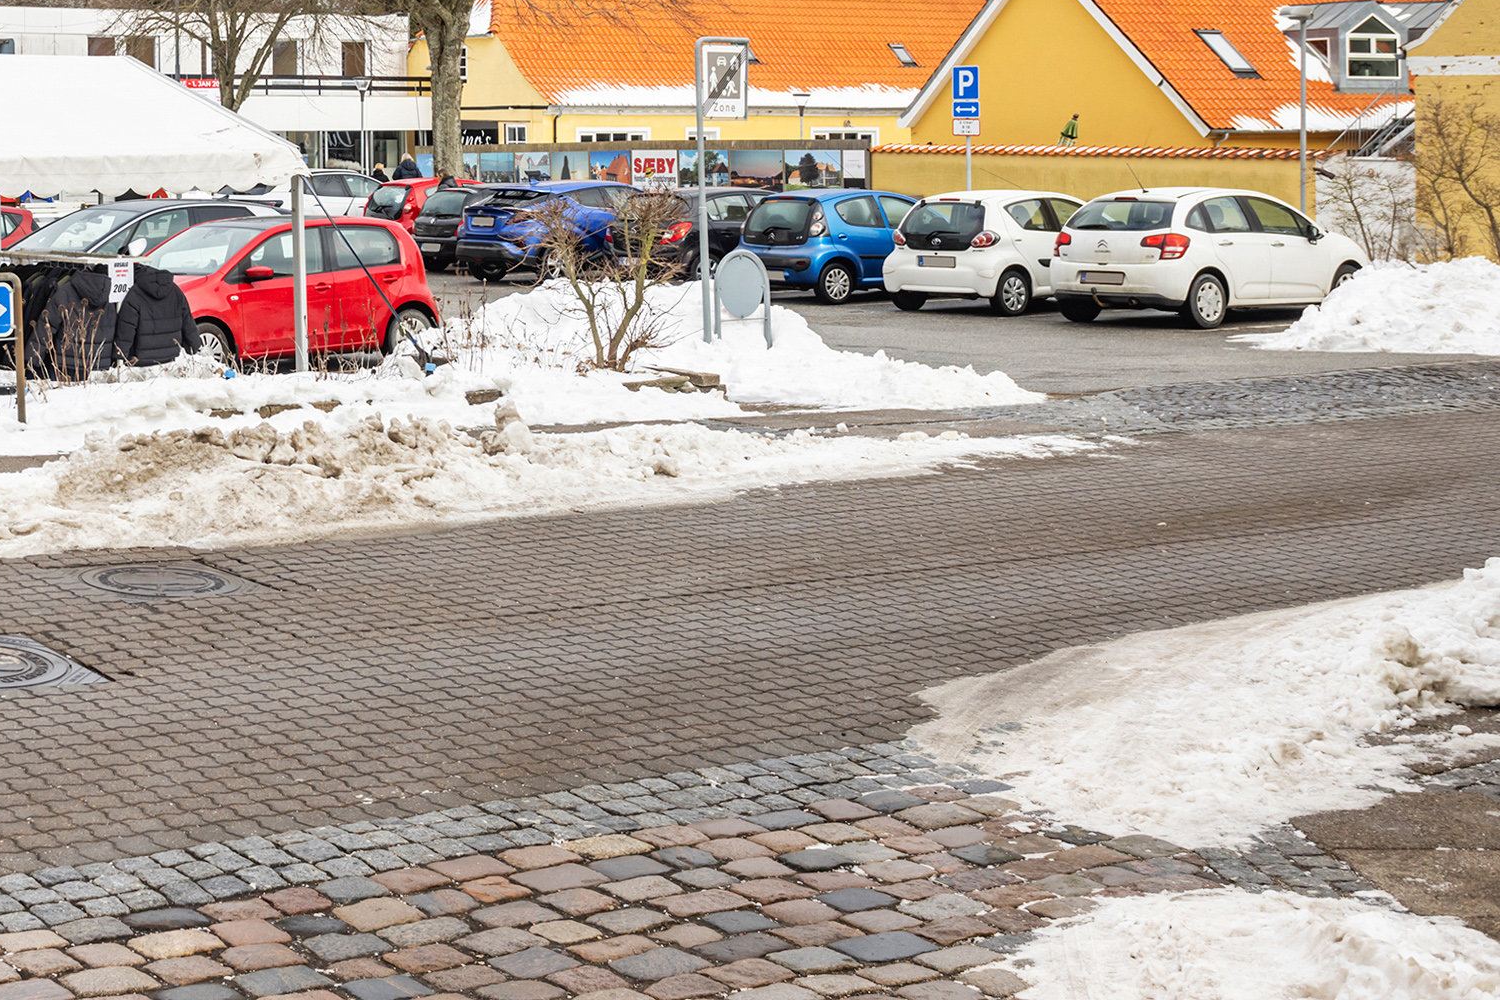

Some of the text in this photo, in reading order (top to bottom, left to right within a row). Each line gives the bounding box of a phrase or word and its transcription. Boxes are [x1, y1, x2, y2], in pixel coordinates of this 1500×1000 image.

[958, 70, 974, 96] P
[713, 102, 736, 113] Zone
[634, 157, 675, 174] SÆBY
